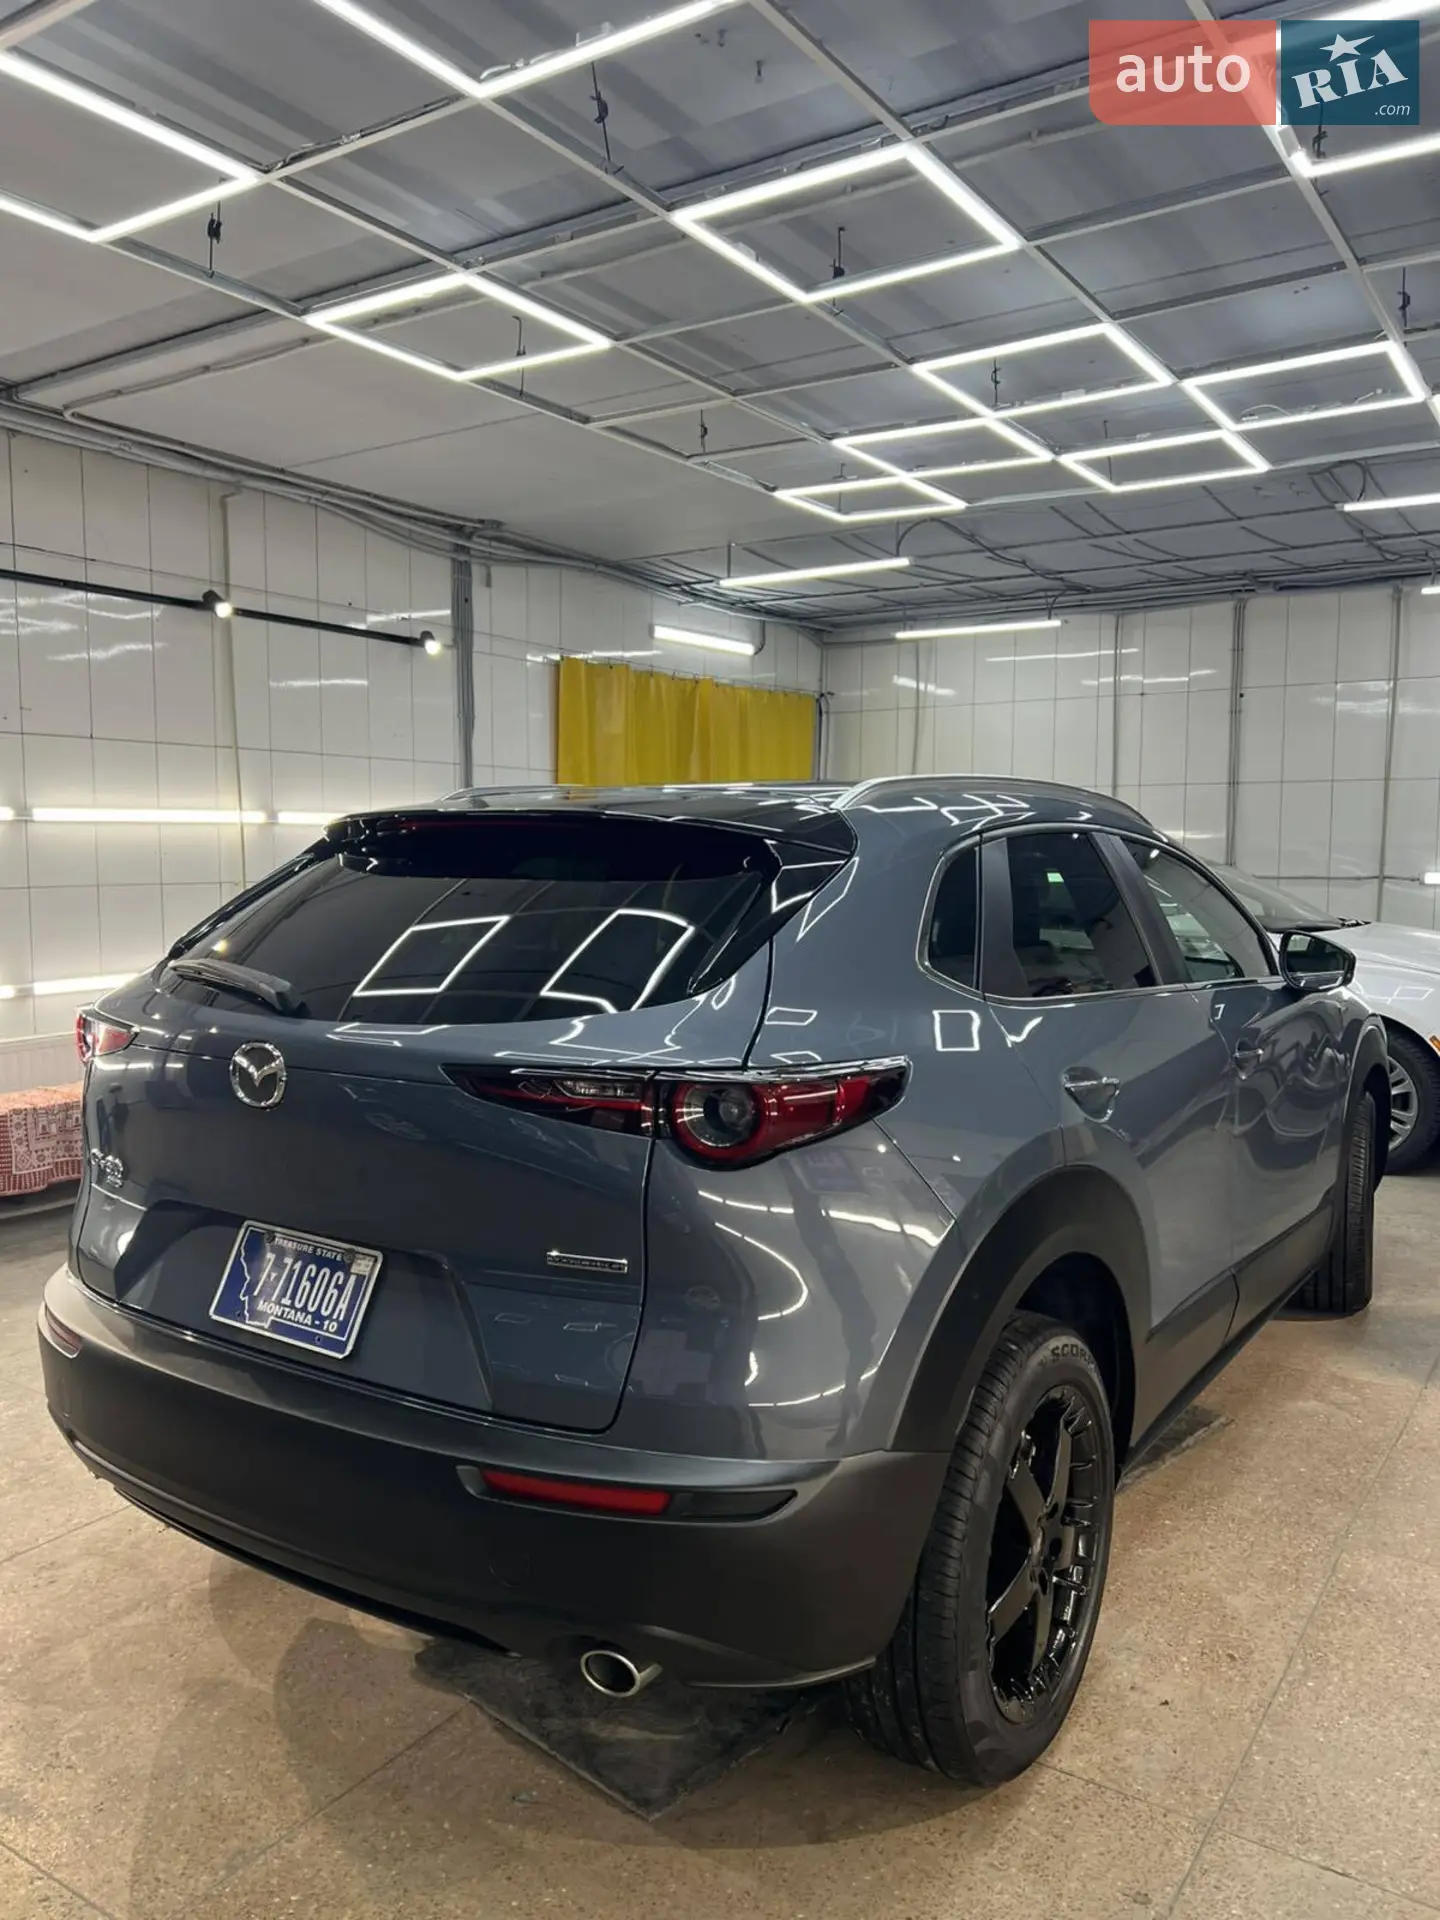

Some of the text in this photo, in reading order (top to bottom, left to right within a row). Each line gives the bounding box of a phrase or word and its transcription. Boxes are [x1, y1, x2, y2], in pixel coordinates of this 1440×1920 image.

[274, 1237, 343, 1262] TREASURE STATE
[257, 1301, 312, 1326] MONTANA
[323, 1321, 338, 1333] 10
